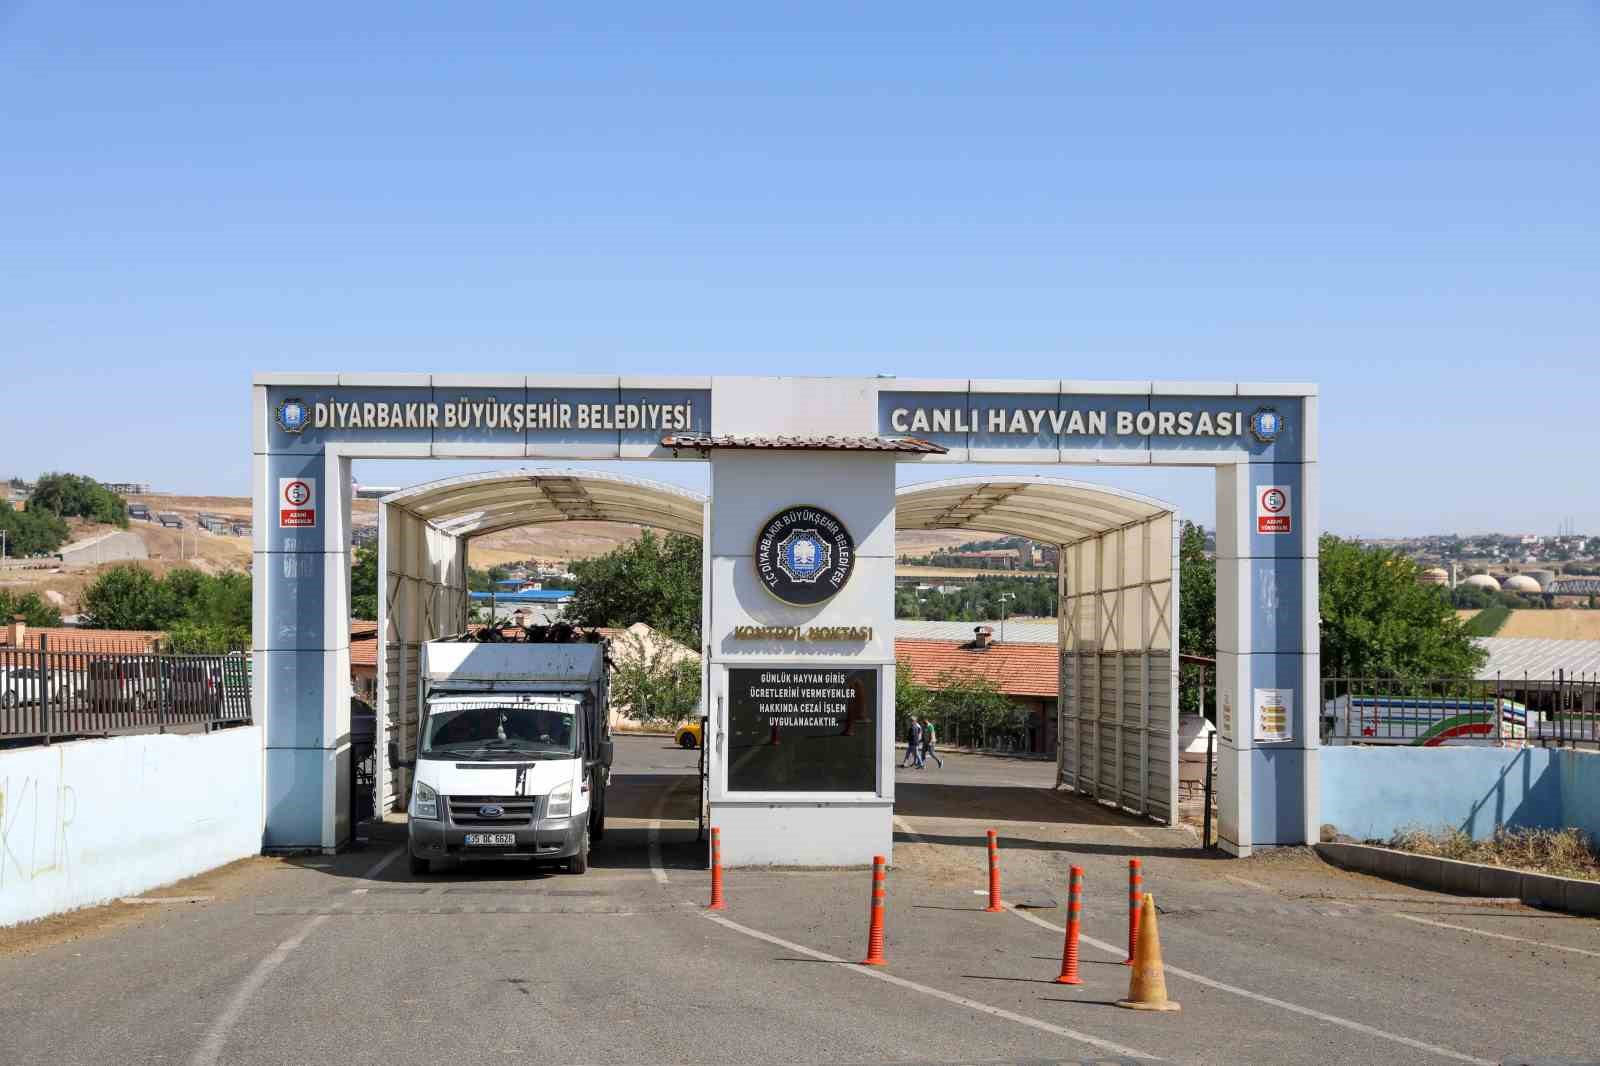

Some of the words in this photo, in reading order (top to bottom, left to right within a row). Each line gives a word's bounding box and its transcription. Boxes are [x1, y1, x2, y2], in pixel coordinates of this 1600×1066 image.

[315, 399, 438, 429] DİYARBAKIR
[444, 397, 571, 432] BÜYÜKŞEHİR
[577, 400, 692, 430] BELEDİYESİ
[891, 408, 978, 433] CANLI
[988, 408, 1107, 436] HAYVAN
[1116, 410, 1243, 437] BORSASI
[735, 626, 801, 641] KONTROL
[806, 626, 873, 641] NOKTASI
[761, 671, 791, 684] GÜNLÜK
[793, 673, 823, 684] HAYVAN
[825, 671, 845, 684] GİRİŞ
[750, 686, 800, 698] ÜCRETLERİNİ
[801, 688, 856, 698] VERMEYENLER
[759, 703, 799, 713] HAKKINDA
[800, 701, 822, 713] CEZAİ
[823, 701, 846, 714] İŞLEM
[769, 717, 839, 727] UYGULANACAKTIR.
